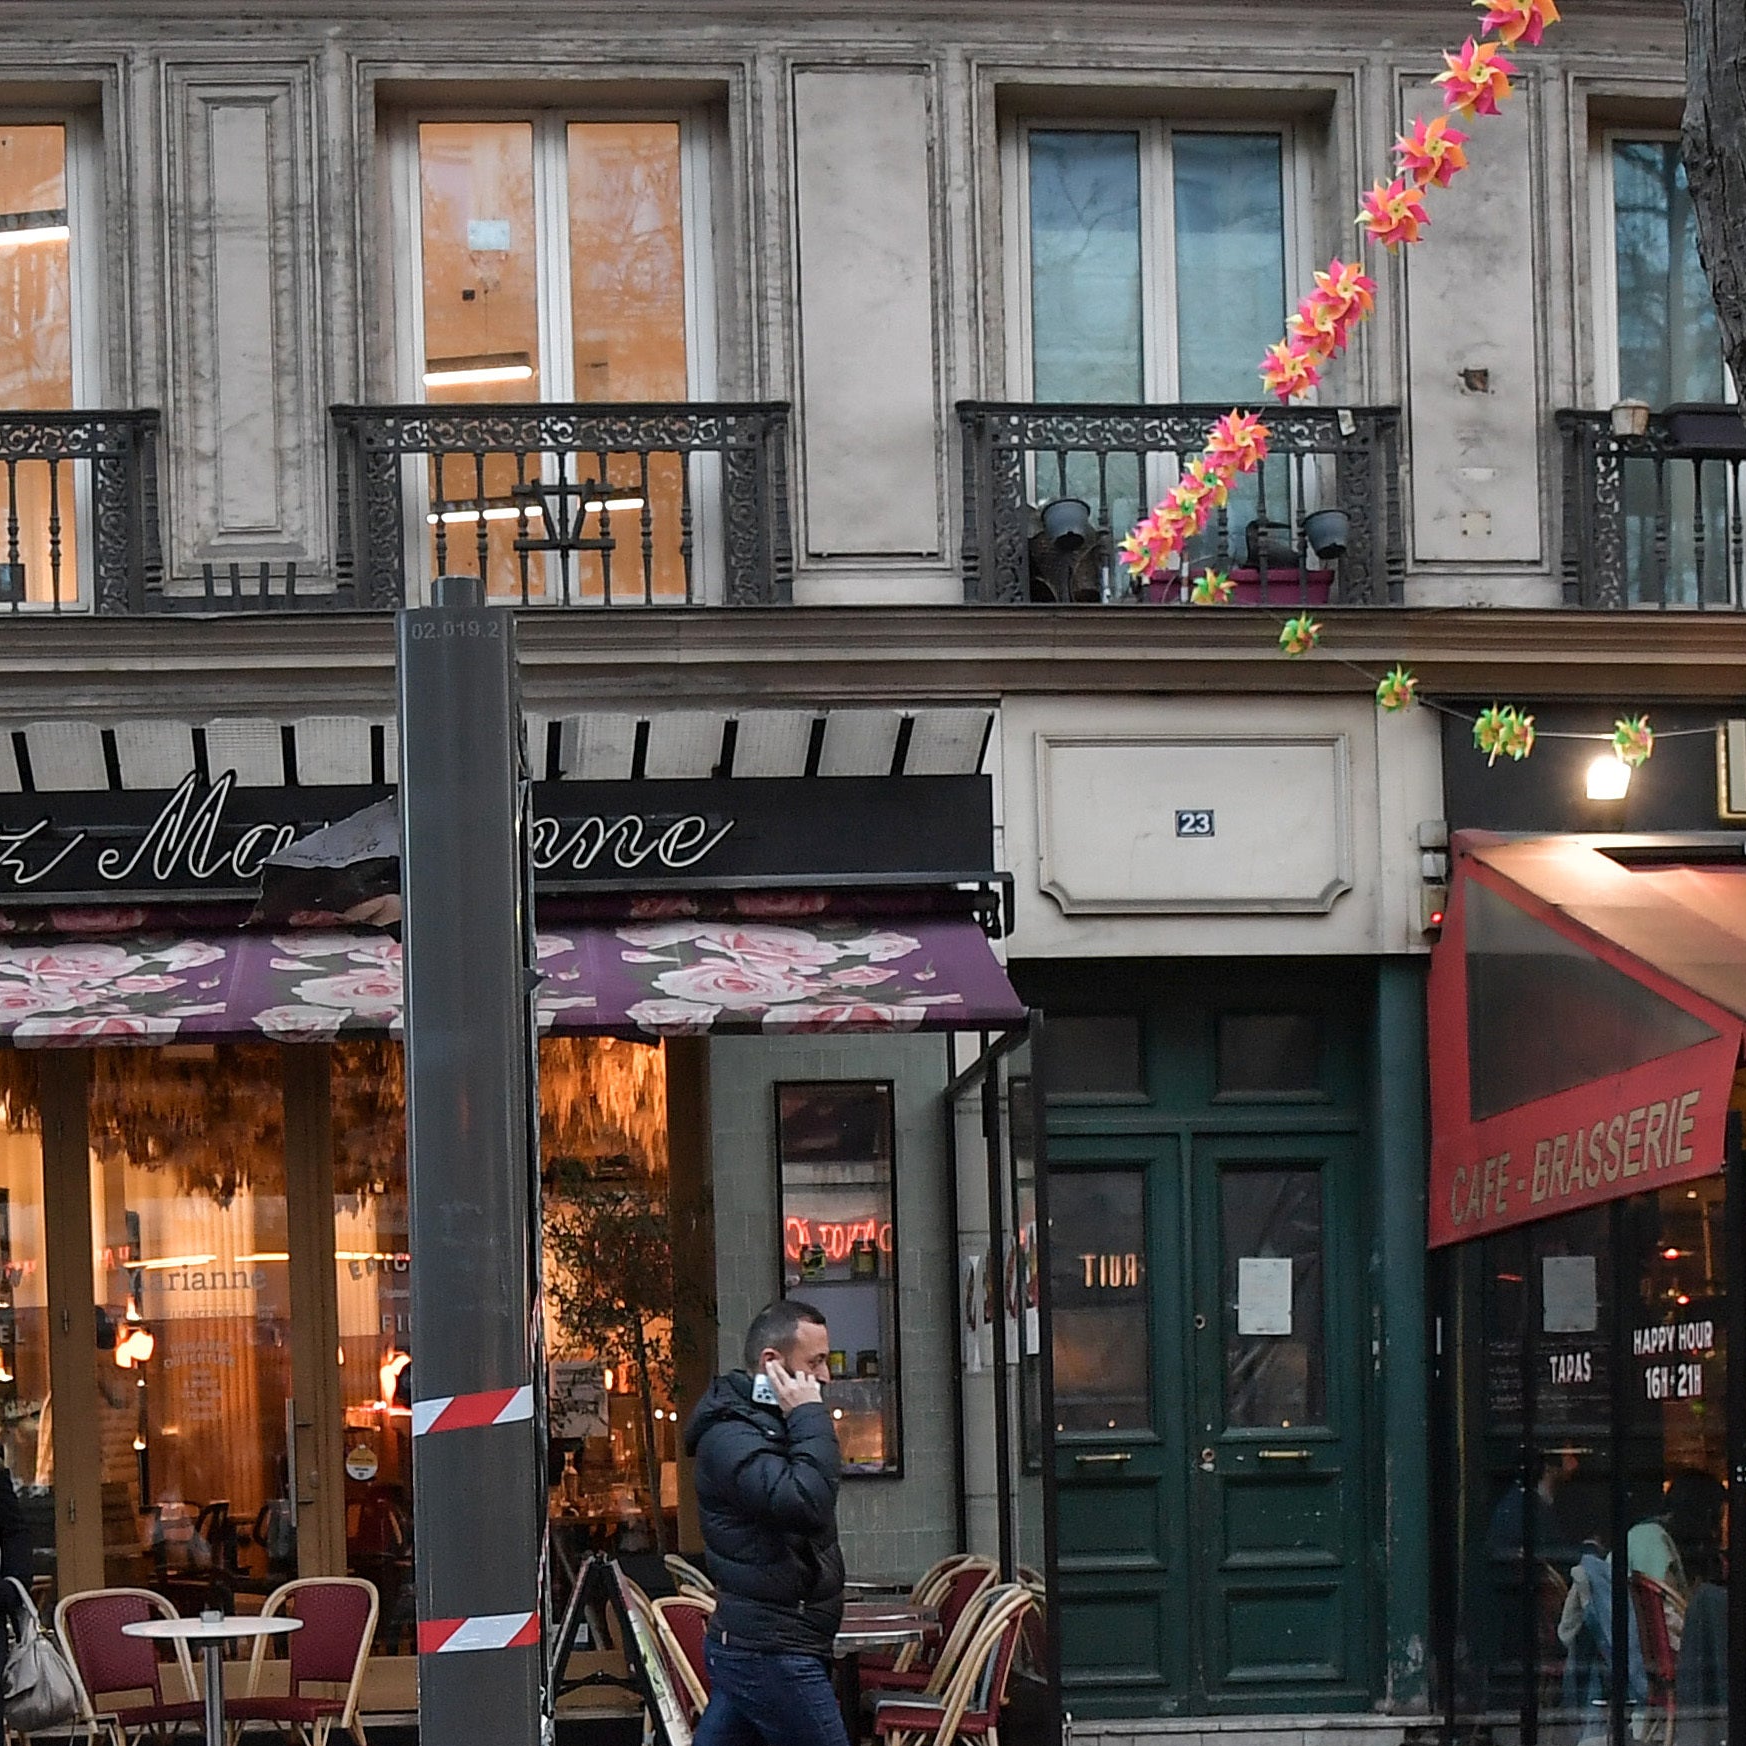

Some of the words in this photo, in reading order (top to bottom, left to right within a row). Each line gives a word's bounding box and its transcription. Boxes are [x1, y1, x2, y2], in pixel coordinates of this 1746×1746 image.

[412, 621, 500, 640] 02.019.2
[1181, 813, 1210, 834] 23
[1451, 1151, 1511, 1227] CAFE
[1530, 1089, 1702, 1205] BRASSERIE
[1633, 1325, 1676, 1356] HAPPY
[1678, 1320, 1714, 1351] HOUR
[1549, 1352, 1592, 1385] TAPAS
